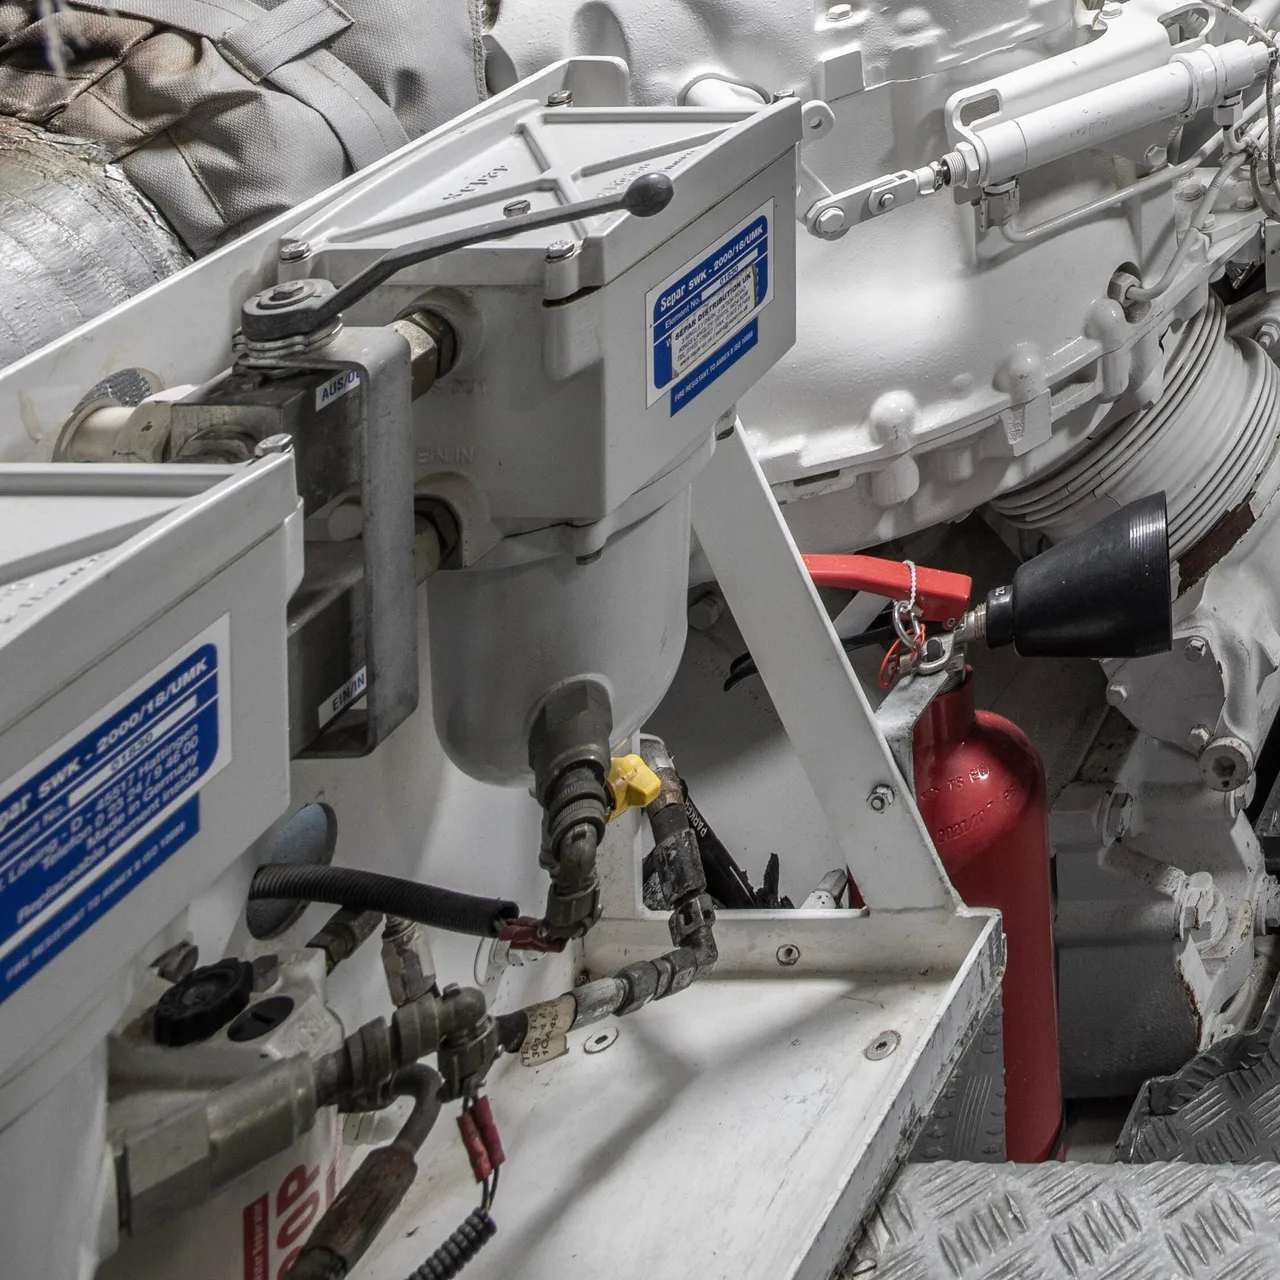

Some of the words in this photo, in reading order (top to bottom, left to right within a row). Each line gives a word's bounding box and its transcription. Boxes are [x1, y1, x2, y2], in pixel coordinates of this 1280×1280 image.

[660, 280, 685, 314] Separ
[688, 269, 706, 291] SWK
[713, 224, 762, 271] 2000/18/UMK
[674, 316, 696, 341] SEPAR
[697, 279, 740, 322] DISTRIBUTION
[742, 270, 751, 284] UK
[664, 303, 689, 330] Element
[38, 754, 80, 801] SWK
[96, 655, 207, 755] 2000/18/UMK
[138, 720, 198, 781] Hattingen
[86, 810, 125, 852] Made
[143, 749, 199, 806] Germany
[108, 797, 159, 849] element
[162, 764, 198, 804] inside
